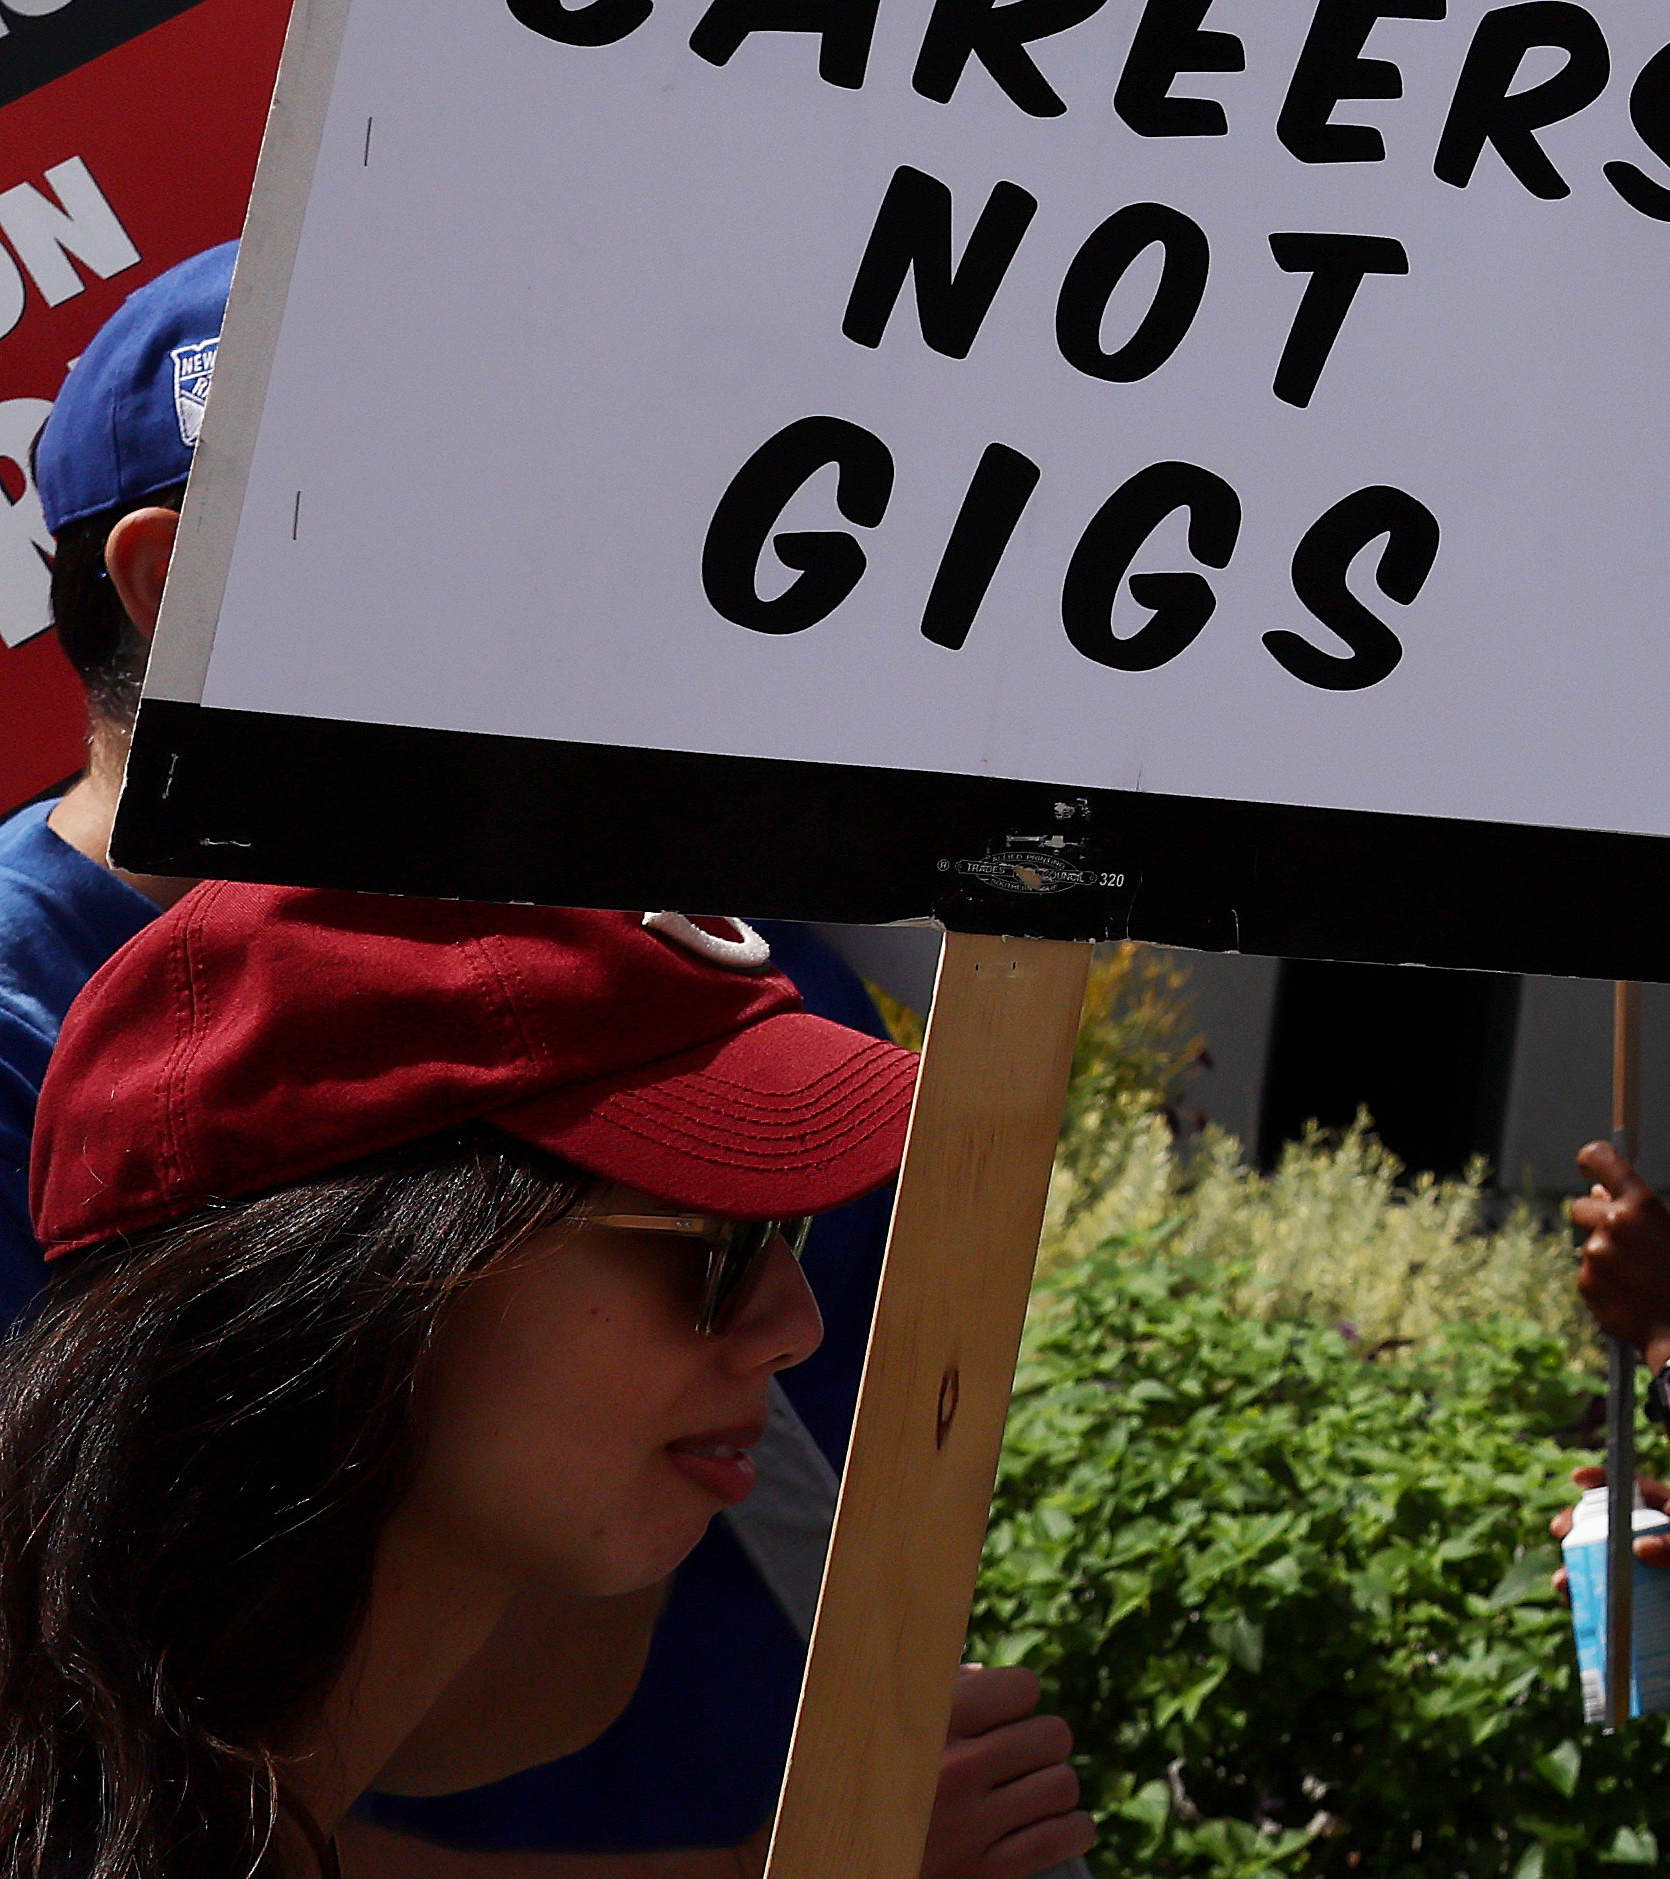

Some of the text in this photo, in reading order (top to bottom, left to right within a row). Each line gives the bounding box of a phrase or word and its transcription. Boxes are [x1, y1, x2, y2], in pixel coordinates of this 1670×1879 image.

[841, 164, 1410, 409] NOT
[701, 414, 1441, 692] GIGS
[1099, 872, 1125, 888] 320
